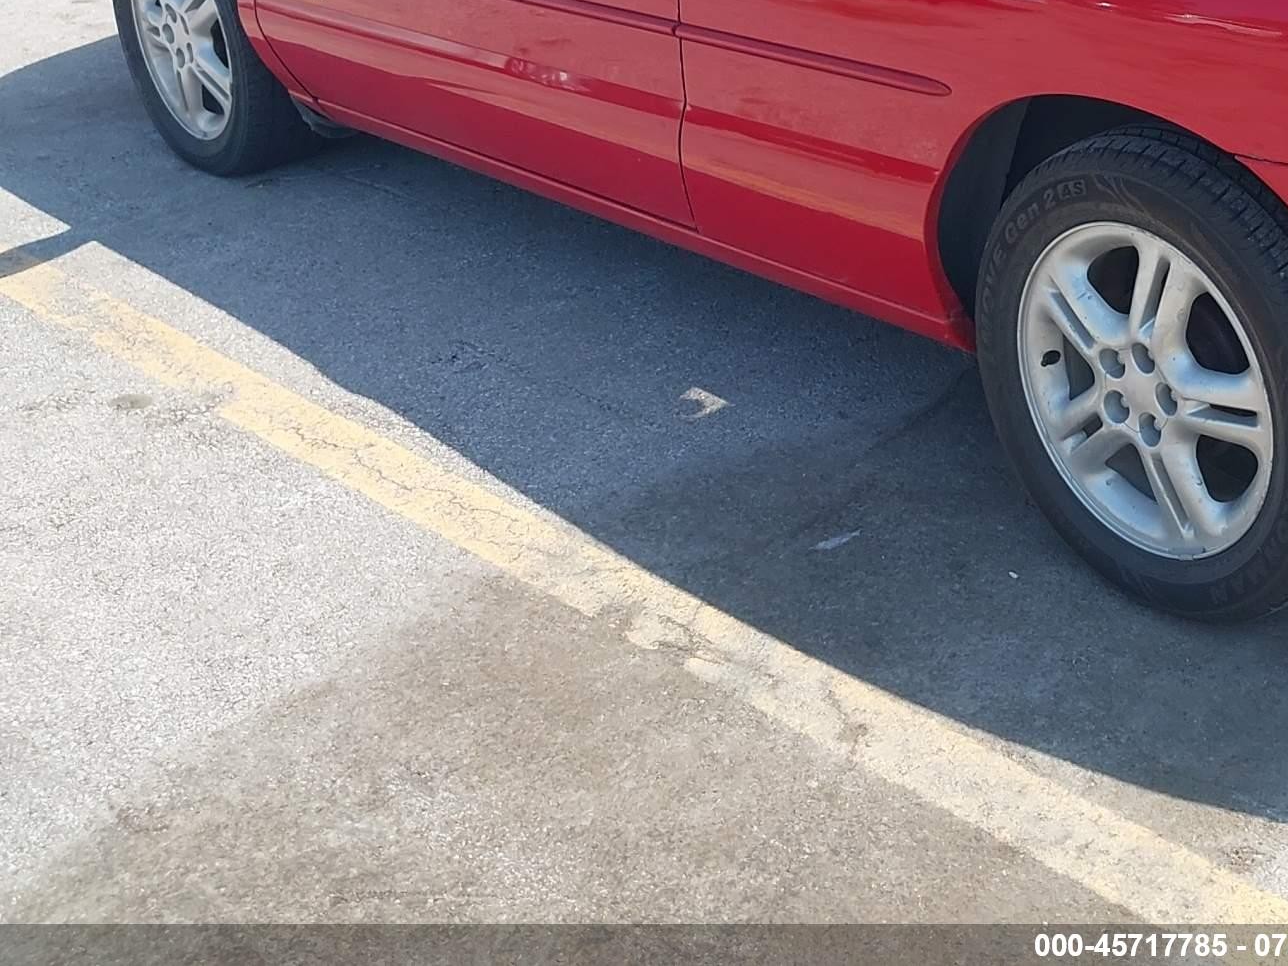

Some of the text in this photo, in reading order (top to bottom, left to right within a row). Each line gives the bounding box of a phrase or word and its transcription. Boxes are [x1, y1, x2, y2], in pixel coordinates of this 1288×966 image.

[1004, 202, 1040, 244] Gen
[1043, 189, 1057, 209] 2
[1059, 180, 1086, 199] AS
